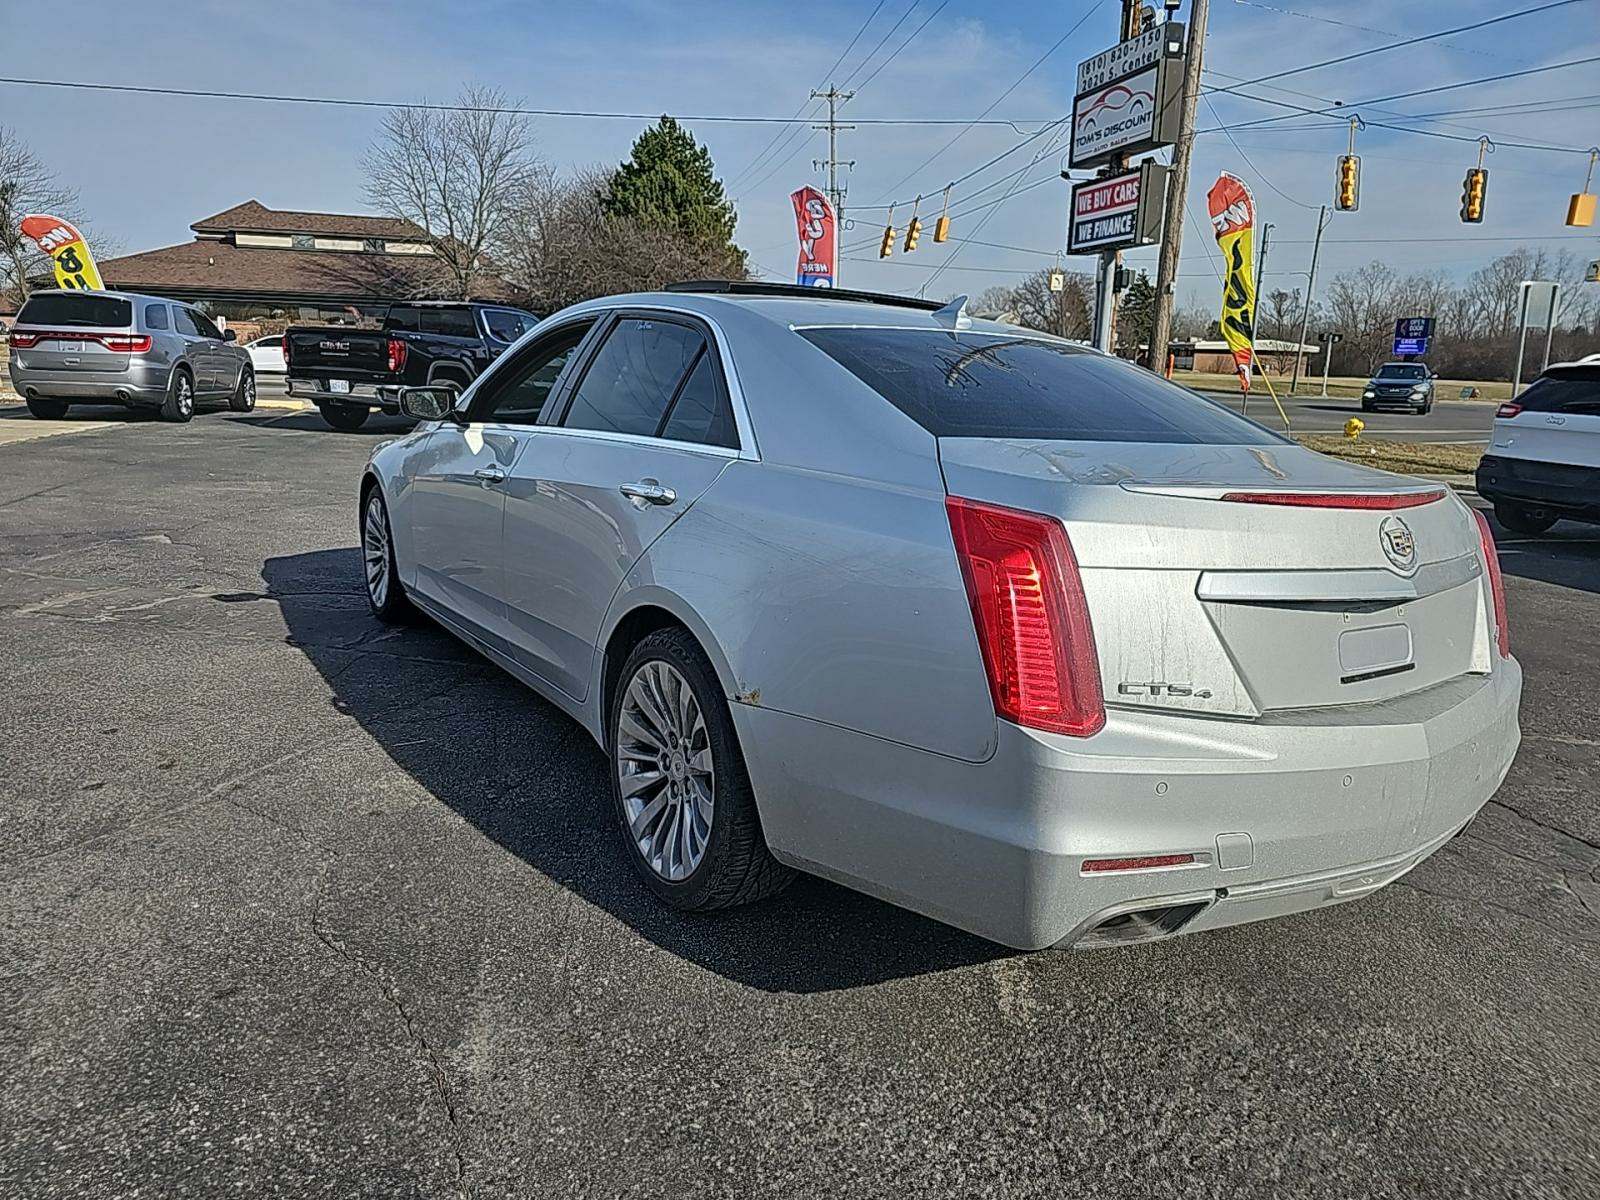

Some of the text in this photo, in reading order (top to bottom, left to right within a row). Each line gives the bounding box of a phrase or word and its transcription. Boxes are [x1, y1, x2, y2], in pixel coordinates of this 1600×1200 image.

[1081, 28, 1161, 78] (810) 820-7150
[1081, 49, 1159, 92] 2020 S. Center
[1076, 110, 1153, 148] TOM'S DISCOUNT
[1093, 143, 1109, 153] AUTO
[1078, 181, 1140, 212] WE BUY CARS
[1078, 222, 1093, 241] WE
[1093, 214, 1133, 239] FINANCE
